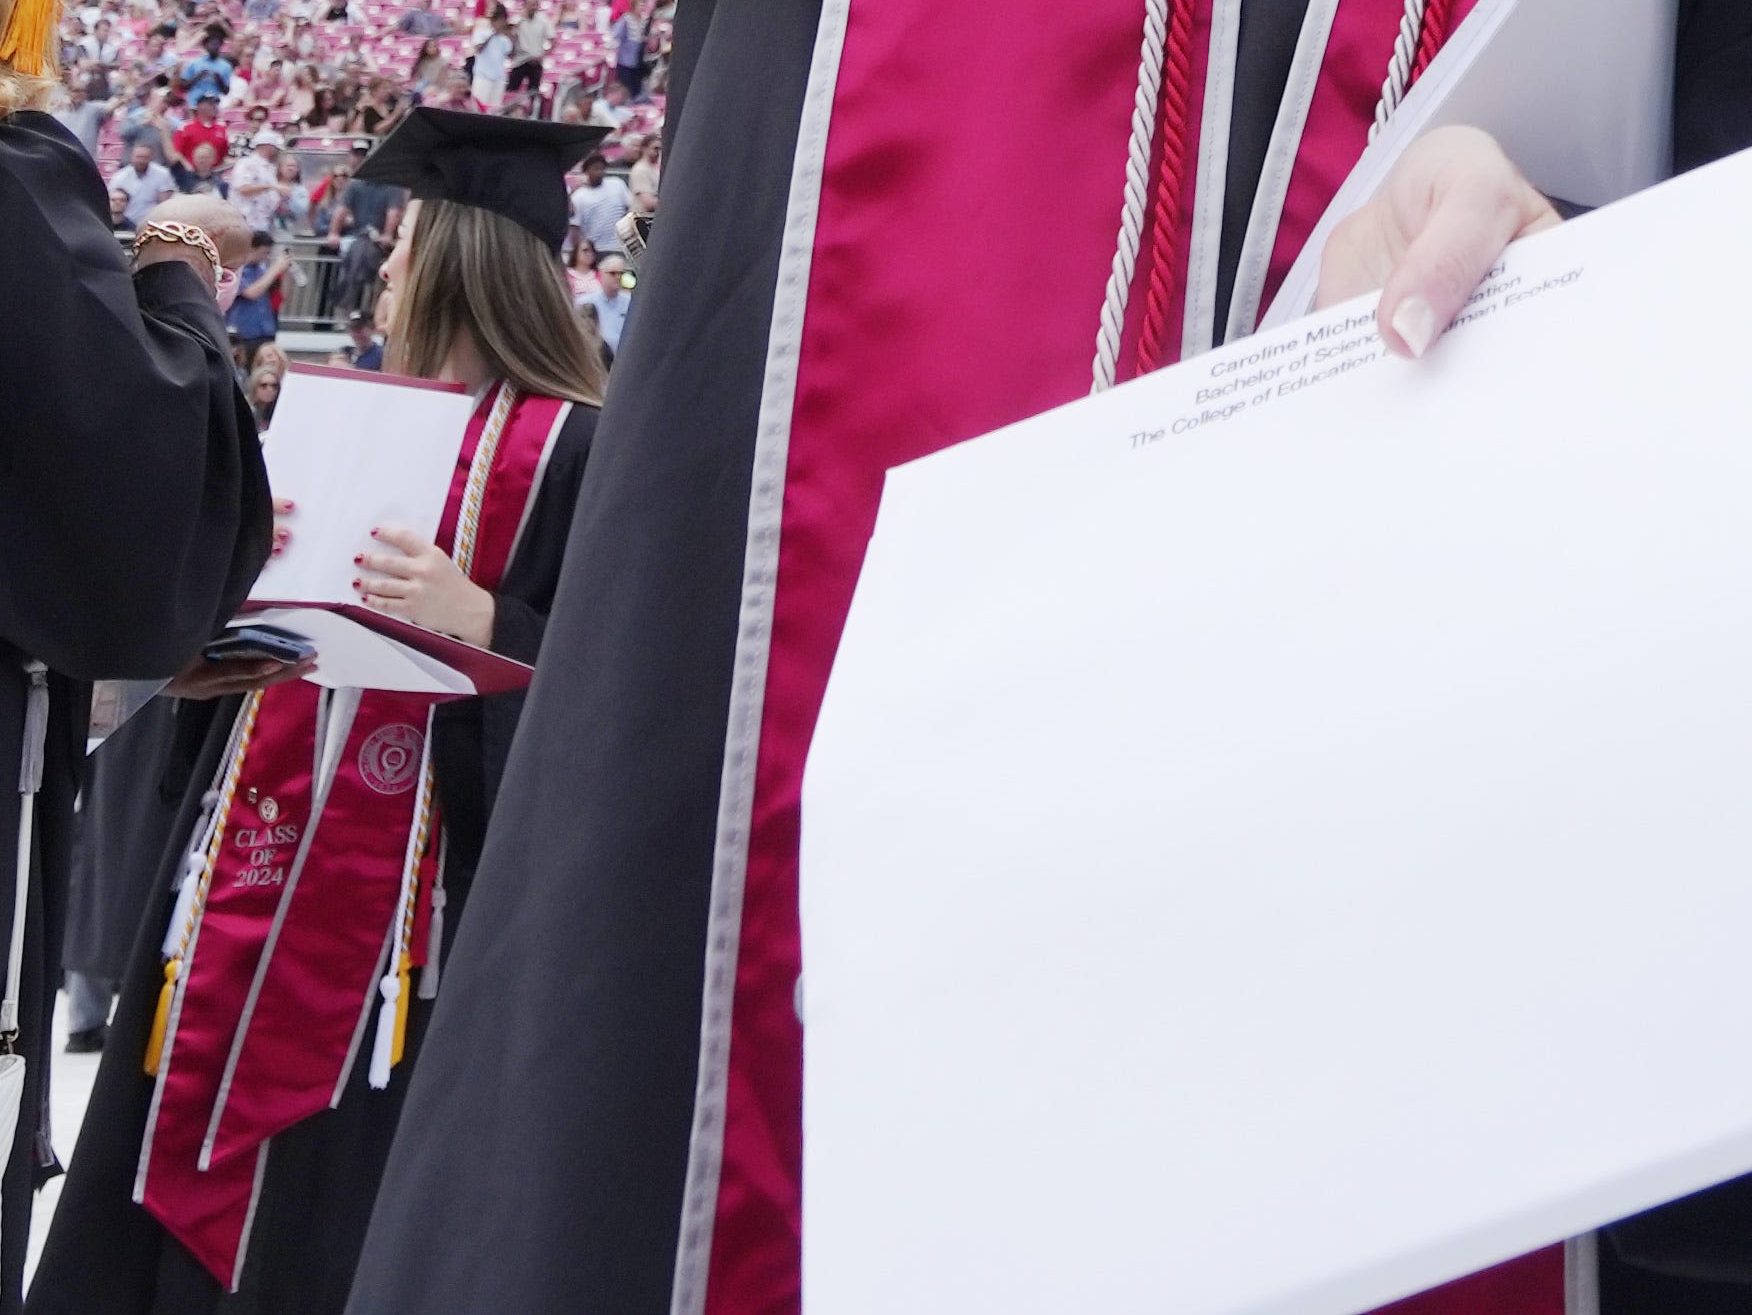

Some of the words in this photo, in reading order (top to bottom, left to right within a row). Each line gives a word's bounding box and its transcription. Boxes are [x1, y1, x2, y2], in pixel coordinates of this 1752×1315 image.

[1128, 428, 1165, 449] The
[1171, 400, 1246, 436] College
[1251, 387, 1271, 407] of
[1277, 353, 1376, 397] Education
[1504, 267, 1584, 307] Ecology
[1210, 340, 1297, 378] Caroline
[1304, 309, 1377, 345] Michel
[1195, 366, 1283, 405] Bachelor
[1289, 354, 1308, 372] of
[1314, 332, 1381, 364] Scienc
[235, 824, 298, 848] CLASS
[250, 848, 277, 867] OF
[232, 866, 283, 888] 2024
